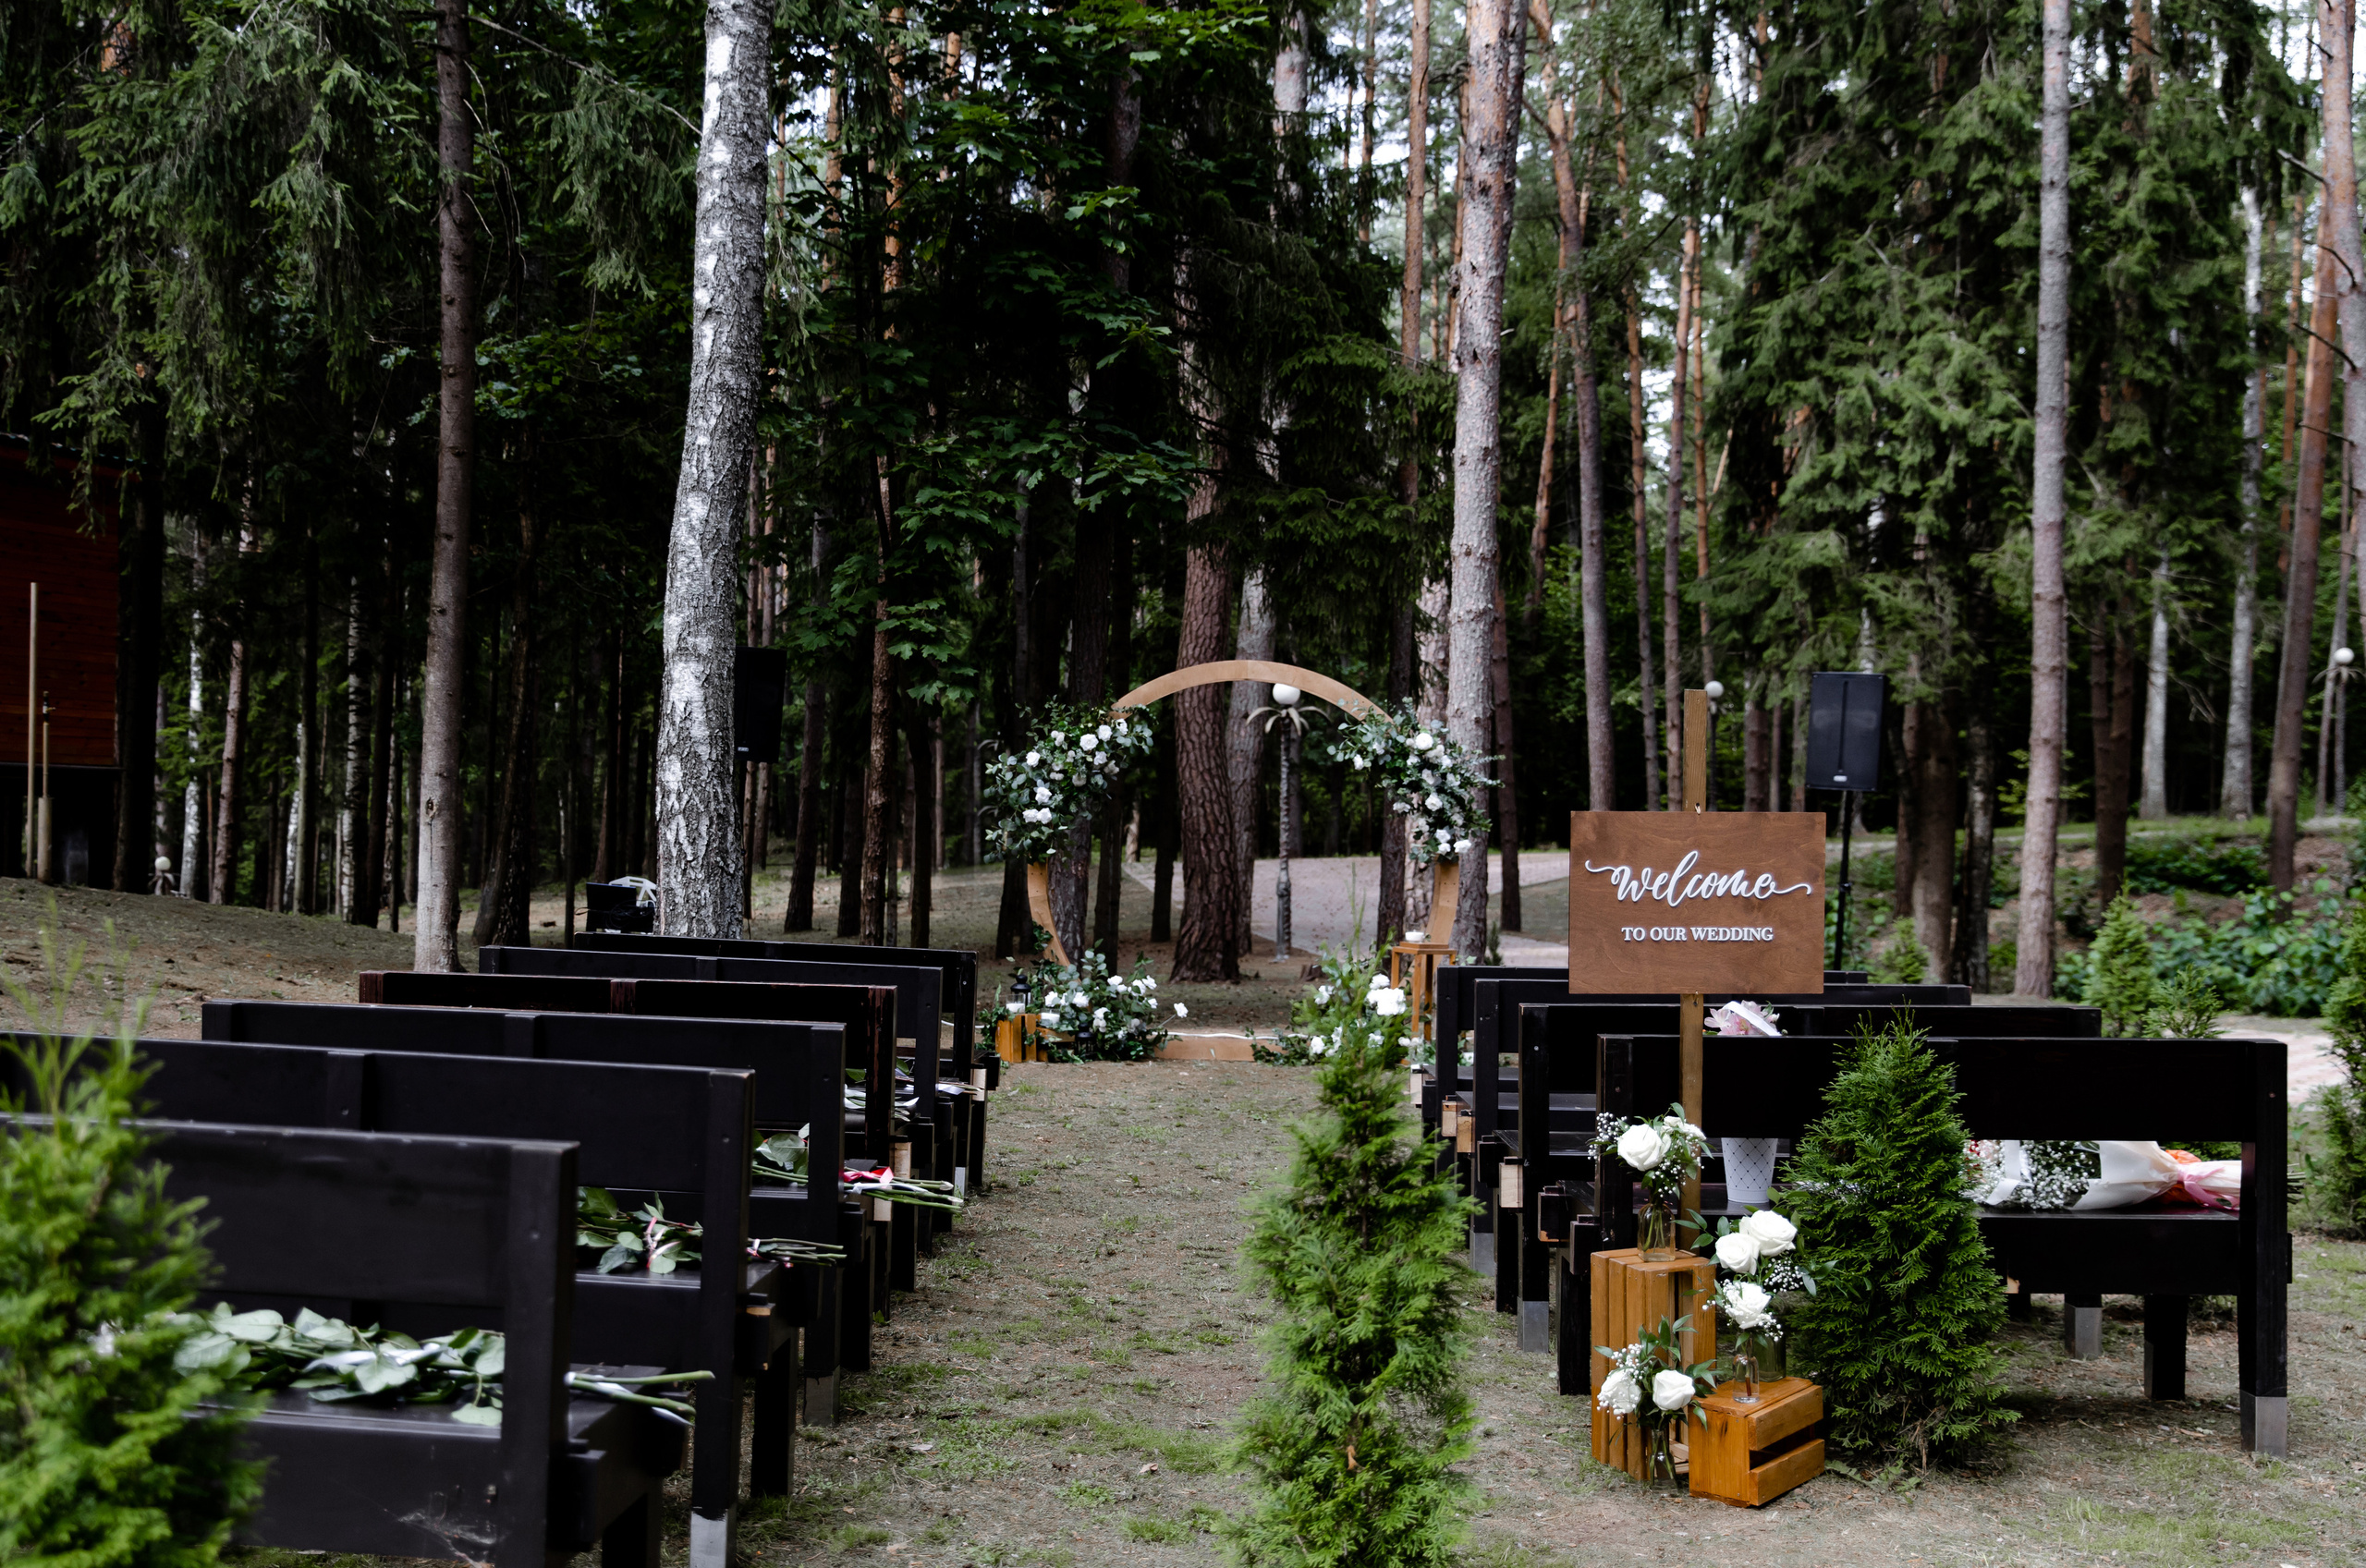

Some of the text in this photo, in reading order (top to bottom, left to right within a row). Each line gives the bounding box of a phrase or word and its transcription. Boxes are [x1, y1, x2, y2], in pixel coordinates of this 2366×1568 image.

[1621, 926, 1774, 942] TO OUR WEDDING
